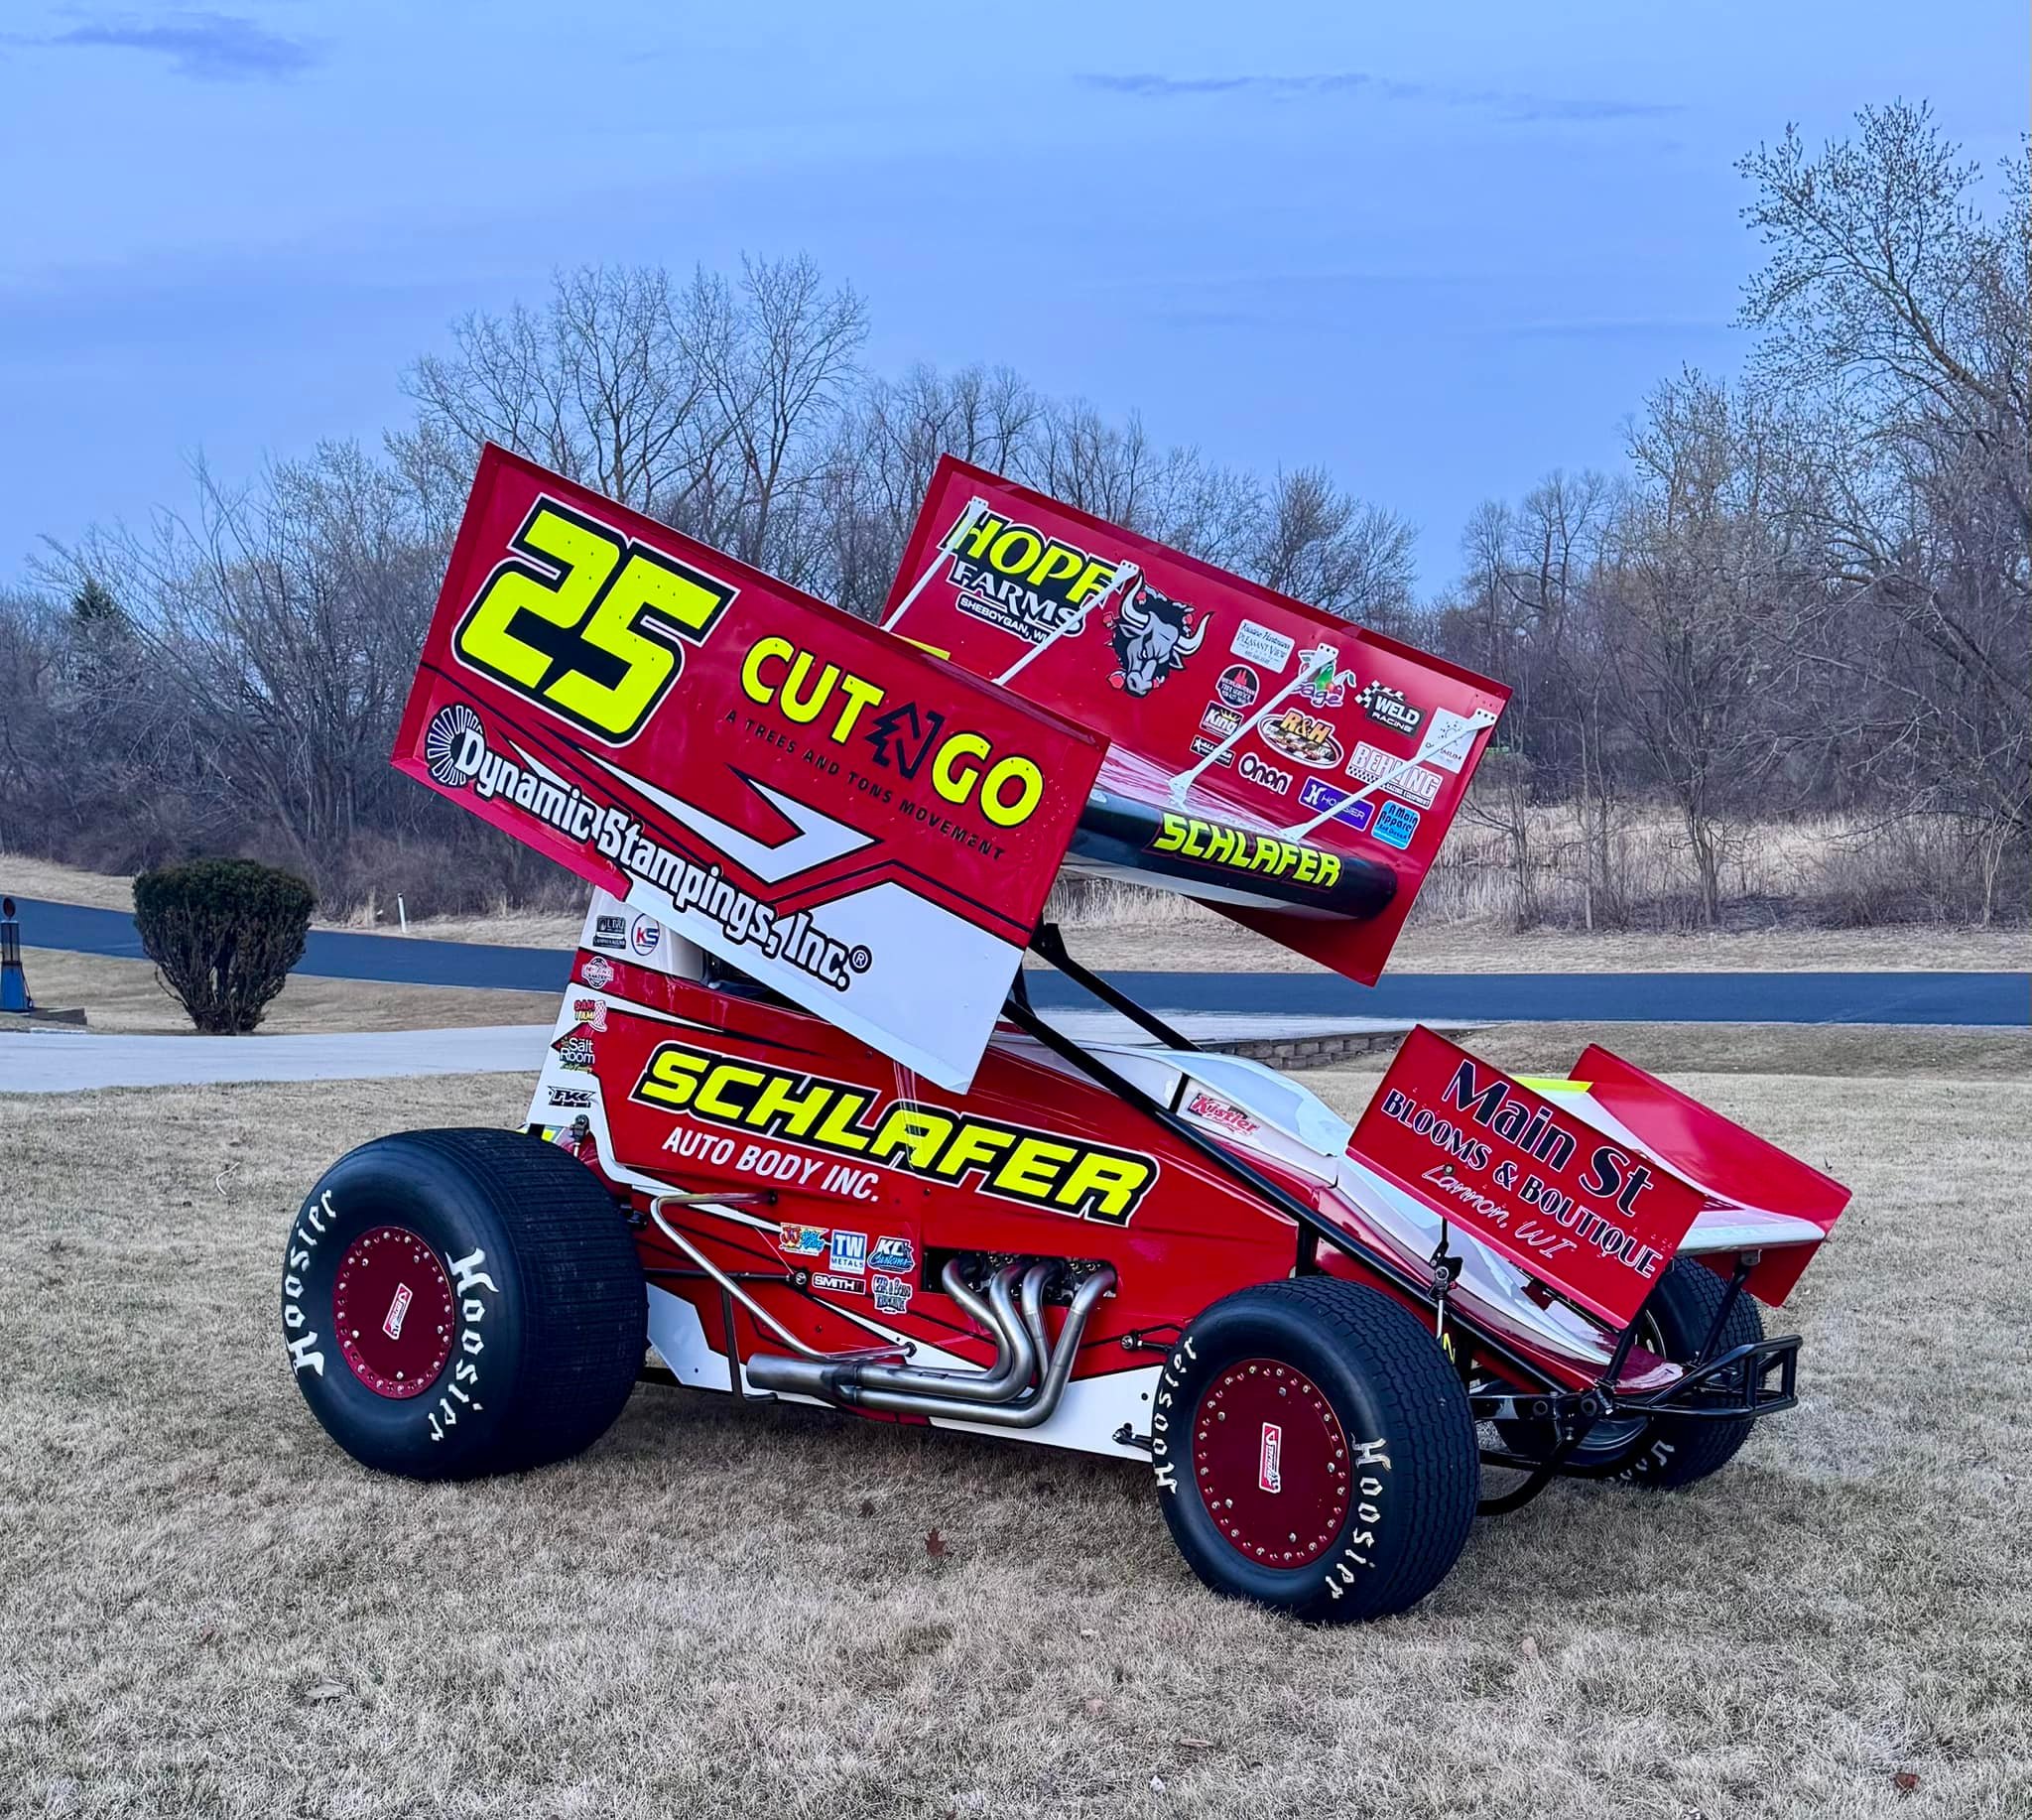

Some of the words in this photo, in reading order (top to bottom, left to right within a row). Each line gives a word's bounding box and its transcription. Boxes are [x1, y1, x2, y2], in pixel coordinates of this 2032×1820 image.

[459, 507, 722, 735] 25
[952, 561, 1081, 632] FARMS
[959, 596, 1030, 637] SHEBOYGAN,
[741, 636, 885, 743] CUT
[932, 732, 1044, 828] GO
[1281, 712, 1333, 743] R&H
[1371, 711, 1415, 733] RACING
[1374, 695, 1422, 726] WELD
[453, 726, 595, 842] Dynamic
[725, 709, 737, 723] A
[744, 719, 797, 755] TREES
[802, 747, 840, 777] AND
[847, 771, 893, 804] TONS
[898, 800, 1006, 861] MOVEMENT
[1240, 754, 1289, 794] Onan
[1322, 794, 1366, 821] HOSIER
[1153, 812, 1342, 888] SCHLAFER
[635, 926, 661, 946] KS
[560, 1048, 595, 1065] Room
[640, 1049, 1150, 1217] SCHLAFER
[1190, 1095, 1261, 1132] Kistler
[1441, 1058, 1578, 1173] Main
[1579, 1145, 1655, 1219] St
[661, 1126, 736, 1166] AUTO
[735, 1144, 825, 1185] BODY
[820, 1164, 879, 1203] INC.
[1380, 1088, 1493, 1171] BLOOMS
[1493, 1160, 1519, 1192] &
[1517, 1174, 1664, 1280] BOUTIQUE
[831, 1256, 864, 1269] METALS
[834, 1234, 864, 1258] TW
[1514, 1220, 1579, 1260] WI
[284, 1189, 336, 1377] Hoosier
[814, 1274, 855, 1291] SMITH
[428, 1246, 499, 1442] Hoosier
[1151, 1336, 1197, 1495] Hoosier
[1326, 1432, 1392, 1600] Hoosier
